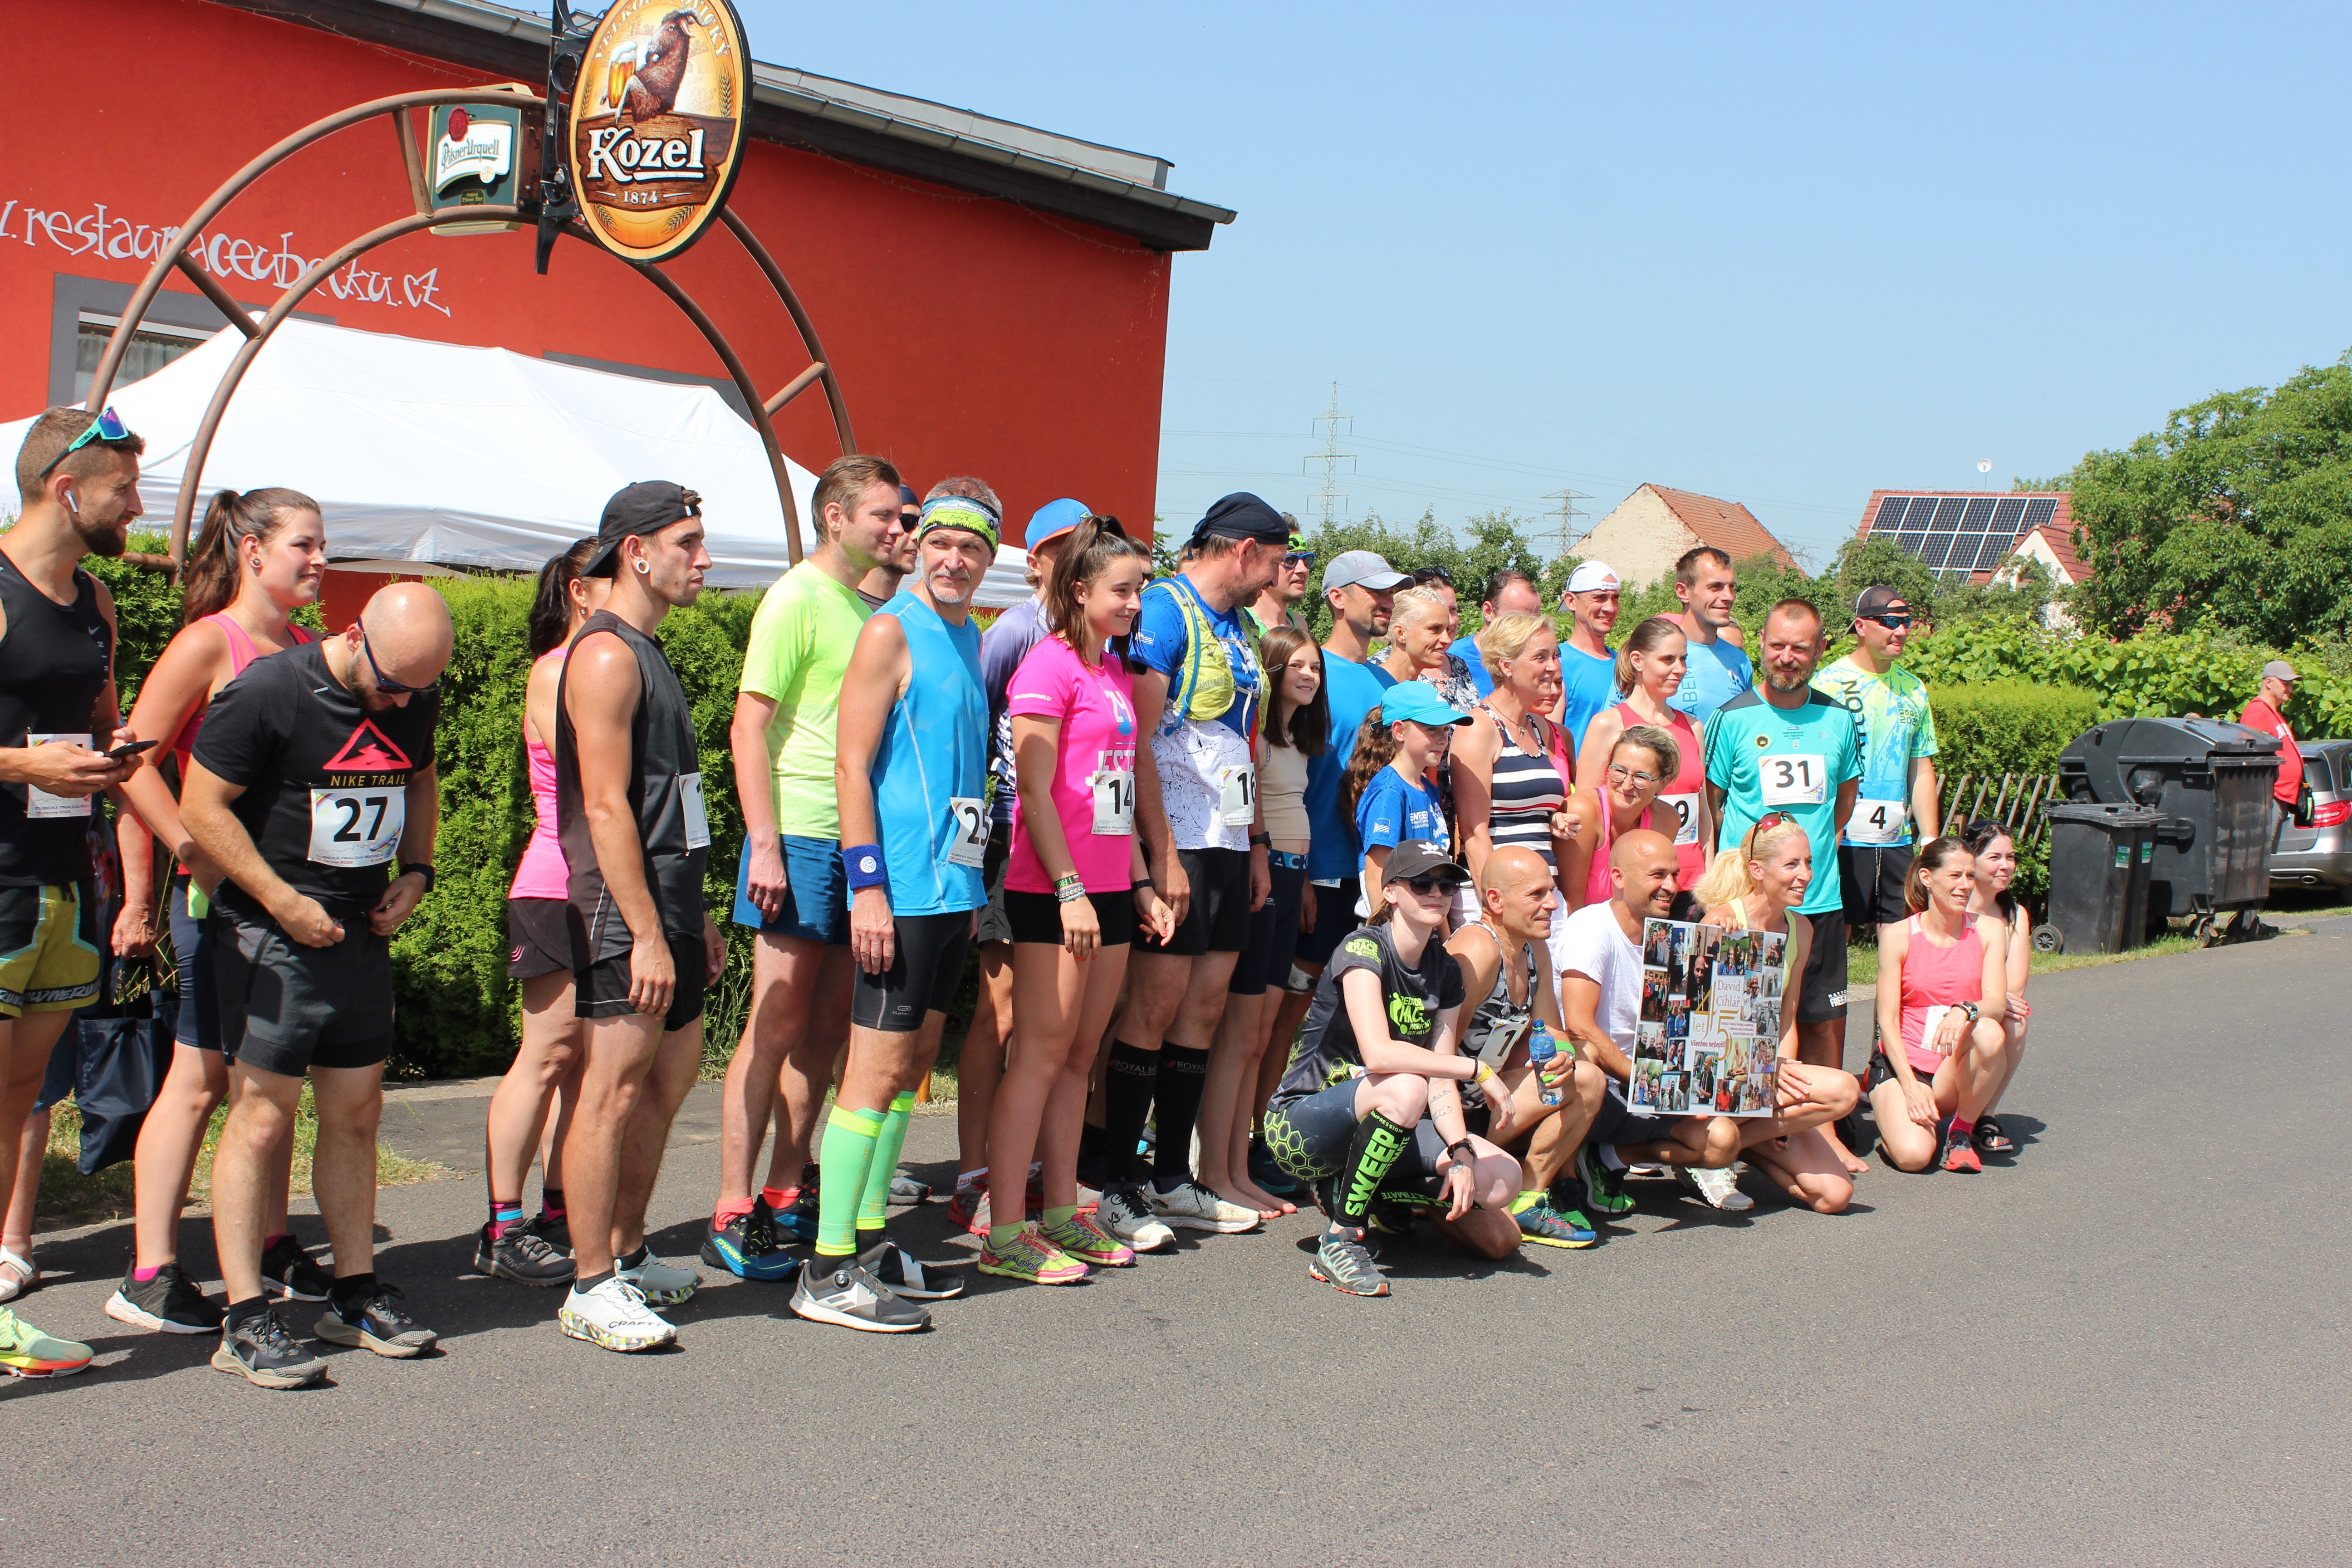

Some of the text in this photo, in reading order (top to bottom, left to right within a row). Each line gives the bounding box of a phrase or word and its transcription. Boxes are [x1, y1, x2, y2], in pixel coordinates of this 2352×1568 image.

[441, 137, 500, 174] Pilsner Urquell
[587, 127, 704, 182] Kozel
[623, 191, 659, 204] 1874
[331, 775, 406, 786] NIKE TRAIL
[1775, 760, 1810, 788] 31
[1237, 771, 1256, 805] 16
[1109, 779, 1133, 814] 14
[333, 796, 388, 842] 27
[1870, 806, 1886, 829] 4
[965, 807, 990, 846] 25
[1354, 938, 1378, 947] PREDATOR
[1354, 942, 1378, 956] RACE
[1717, 980, 1741, 992] David
[1716, 995, 1740, 1007] Cihlář
[1693, 1017, 1706, 1032] let
[1709, 1041, 1726, 1049] nejlepší!
[1116, 1059, 1146, 1073] ROYAL
[1177, 1061, 1205, 1071] ROYAL
[1344, 1127, 1399, 1217] SWEEP
[716, 1238, 751, 1265] DYNAFIT
[799, 1284, 809, 1298] TERREX
[608, 1320, 657, 1328] CRAFT
